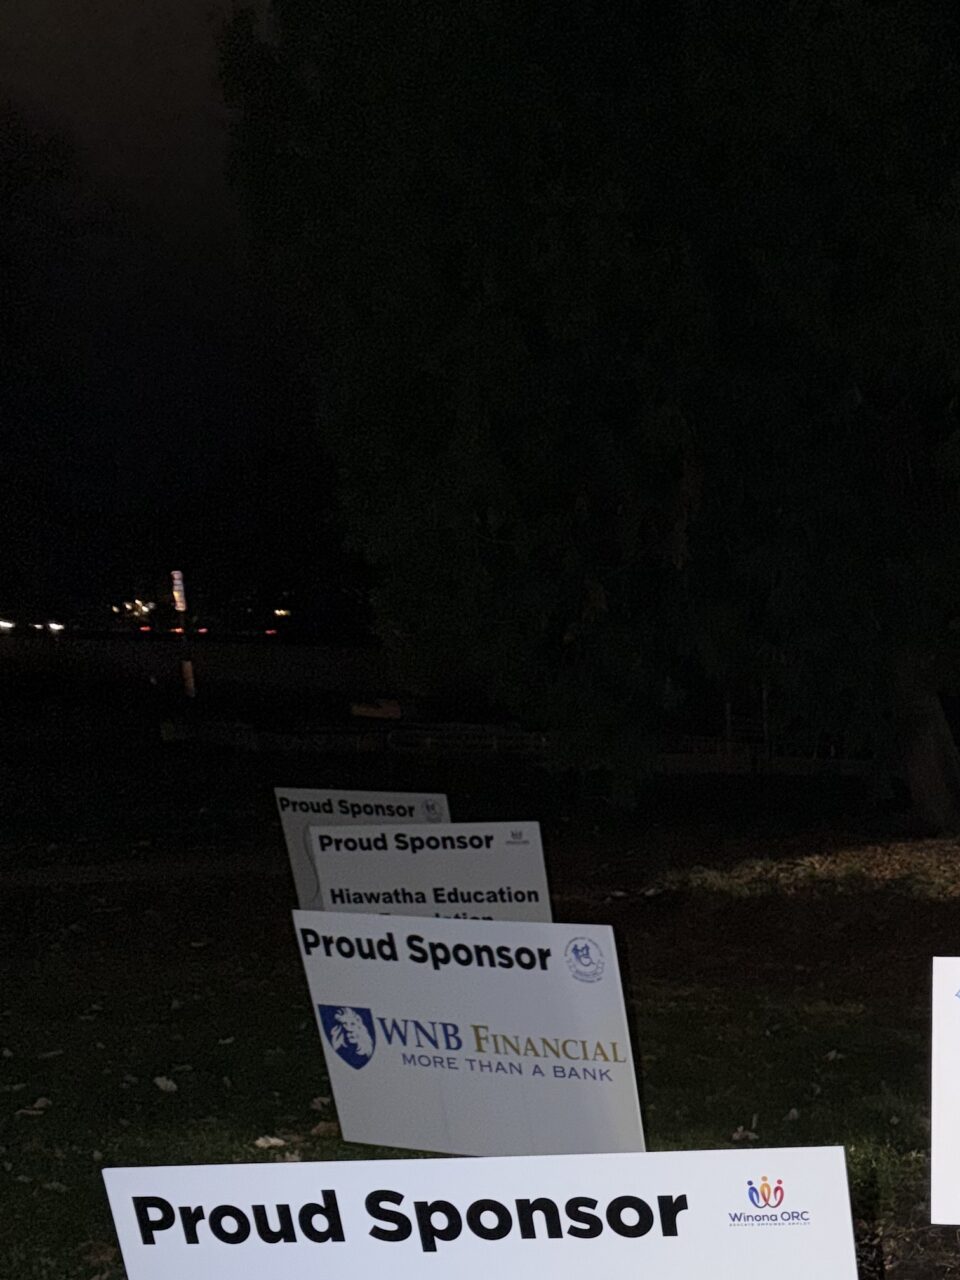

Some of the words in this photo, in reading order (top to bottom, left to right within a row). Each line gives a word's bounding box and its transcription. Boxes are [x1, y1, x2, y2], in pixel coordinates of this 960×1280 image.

[279, 797, 333, 814] Proud
[339, 799, 415, 820] Sponsor
[319, 833, 388, 851] Proud
[395, 832, 494, 854] Sponsor
[330, 887, 426, 904] Hiawatha
[433, 886, 540, 904] Education
[300, 927, 398, 962] Proud
[406, 935, 552, 971] Sponsor
[377, 1017, 463, 1051] WNB
[471, 1024, 626, 1064] FINANCIAL
[402, 1053, 459, 1071] MORE
[465, 1058, 523, 1075] THAN
[531, 1063, 545, 1077] A
[552, 1065, 613, 1082] BANK
[131, 1190, 346, 1245] Proud
[365, 1190, 689, 1252] Sponsor
[728, 1212, 778, 1222] Winona
[780, 1210, 810, 1222] ORC
